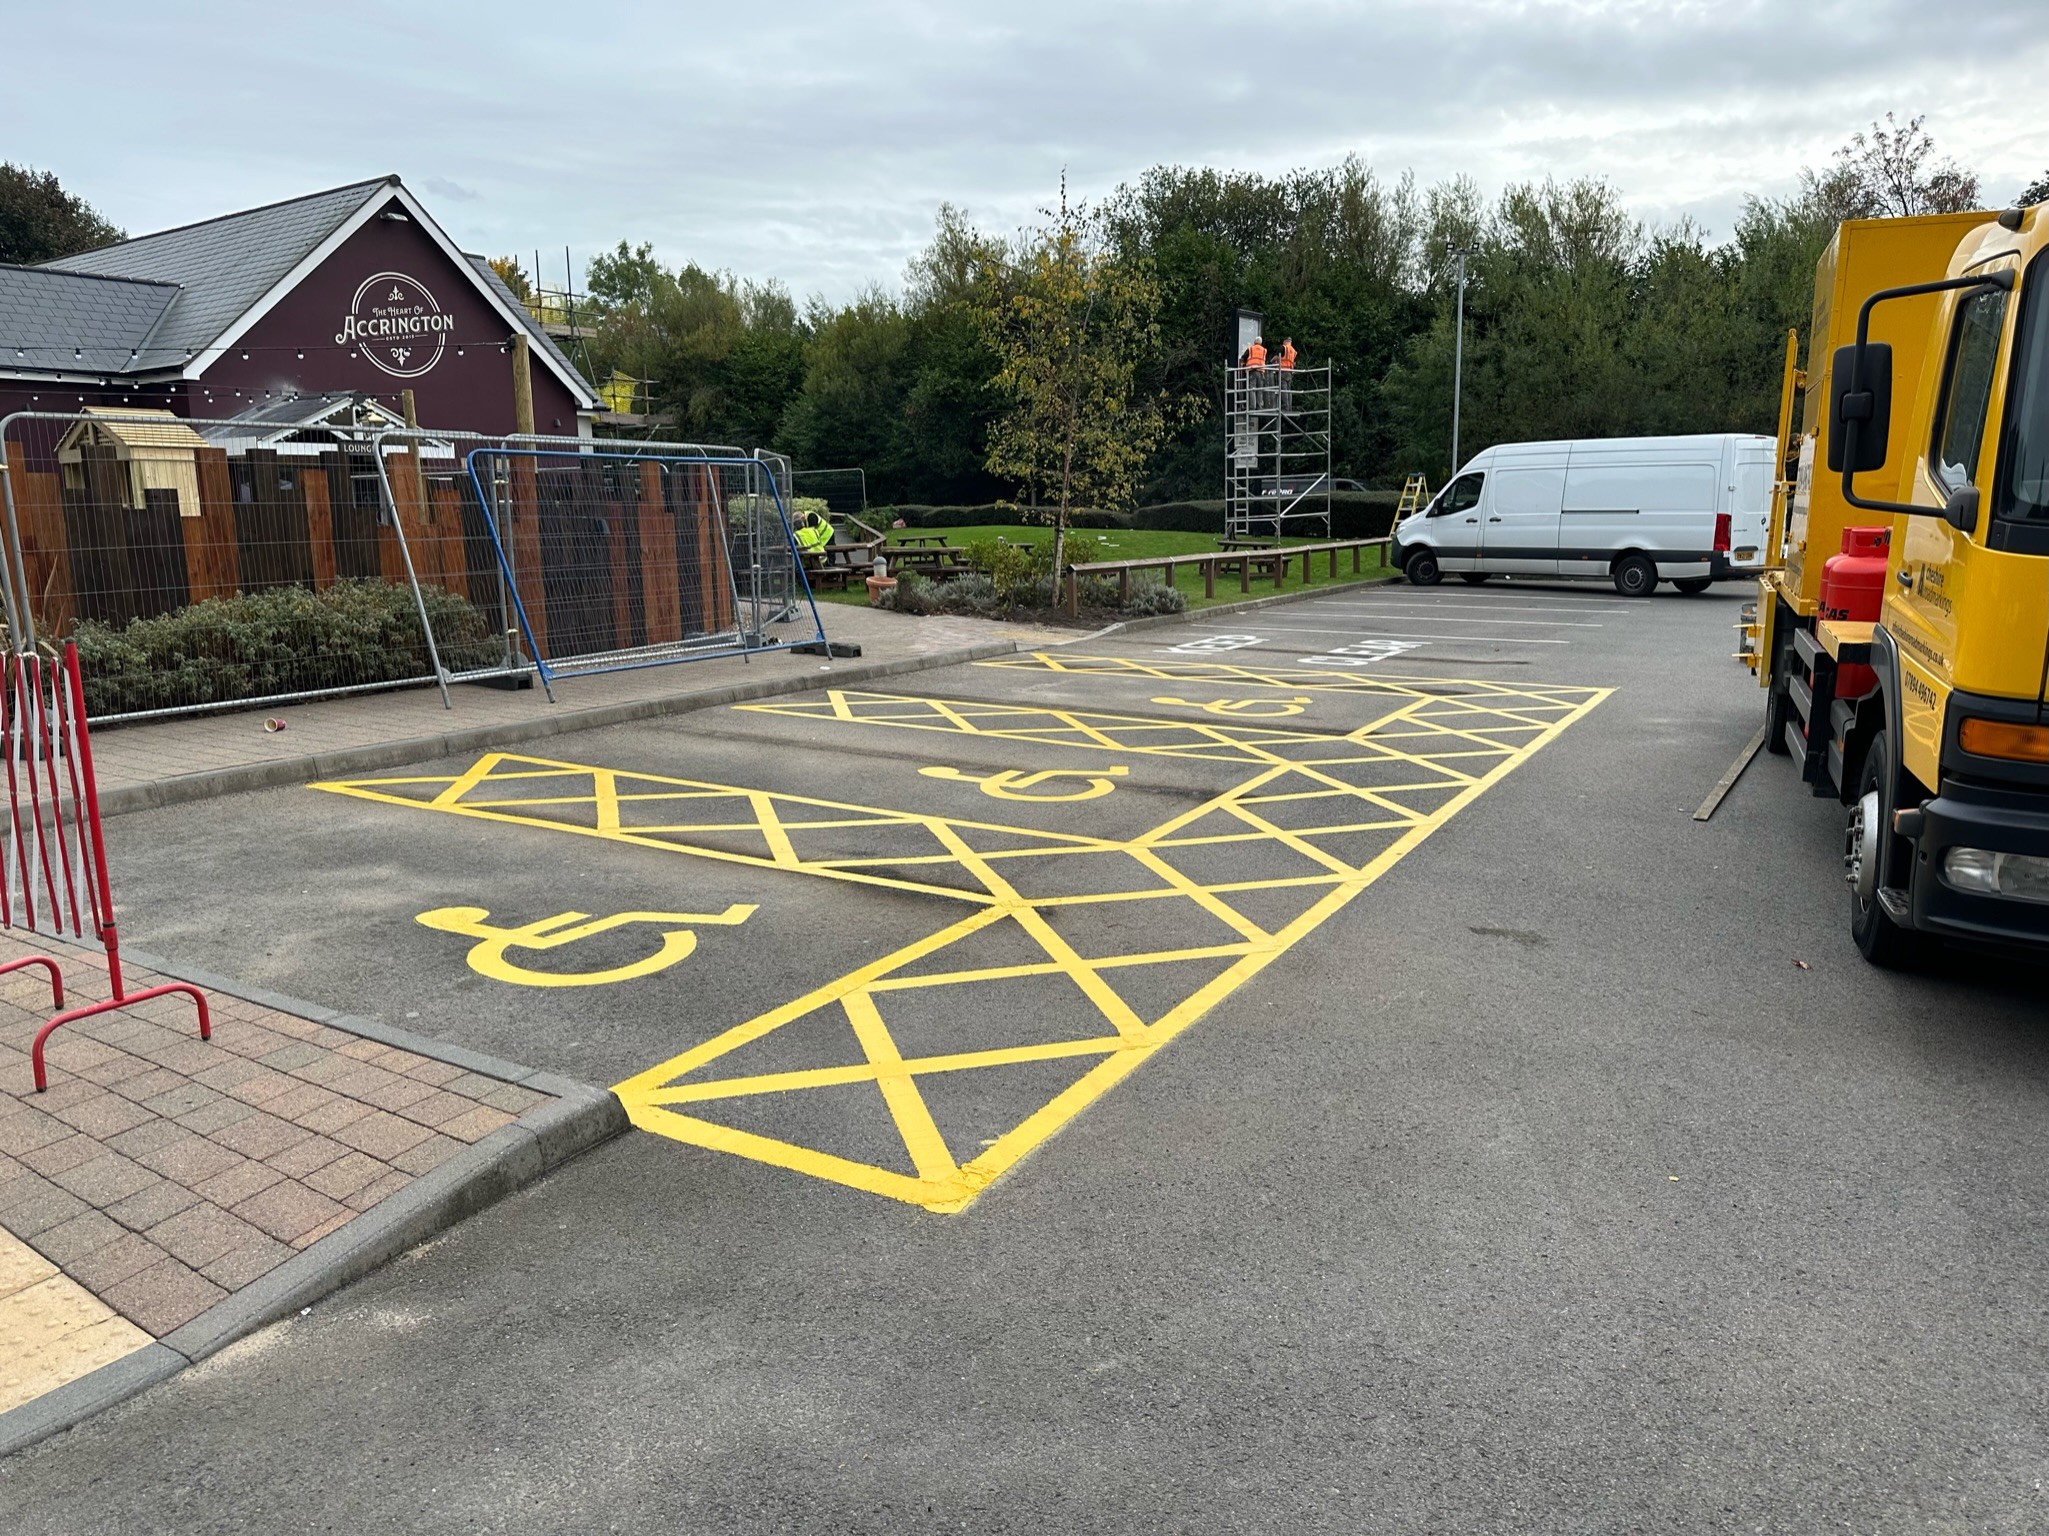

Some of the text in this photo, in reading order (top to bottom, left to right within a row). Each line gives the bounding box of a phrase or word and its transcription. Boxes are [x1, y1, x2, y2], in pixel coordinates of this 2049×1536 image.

[335, 314, 454, 345] ACCRINGTON
[1152, 634, 1270, 655] KEEP
[1296, 639, 1434, 666] CLEAR
